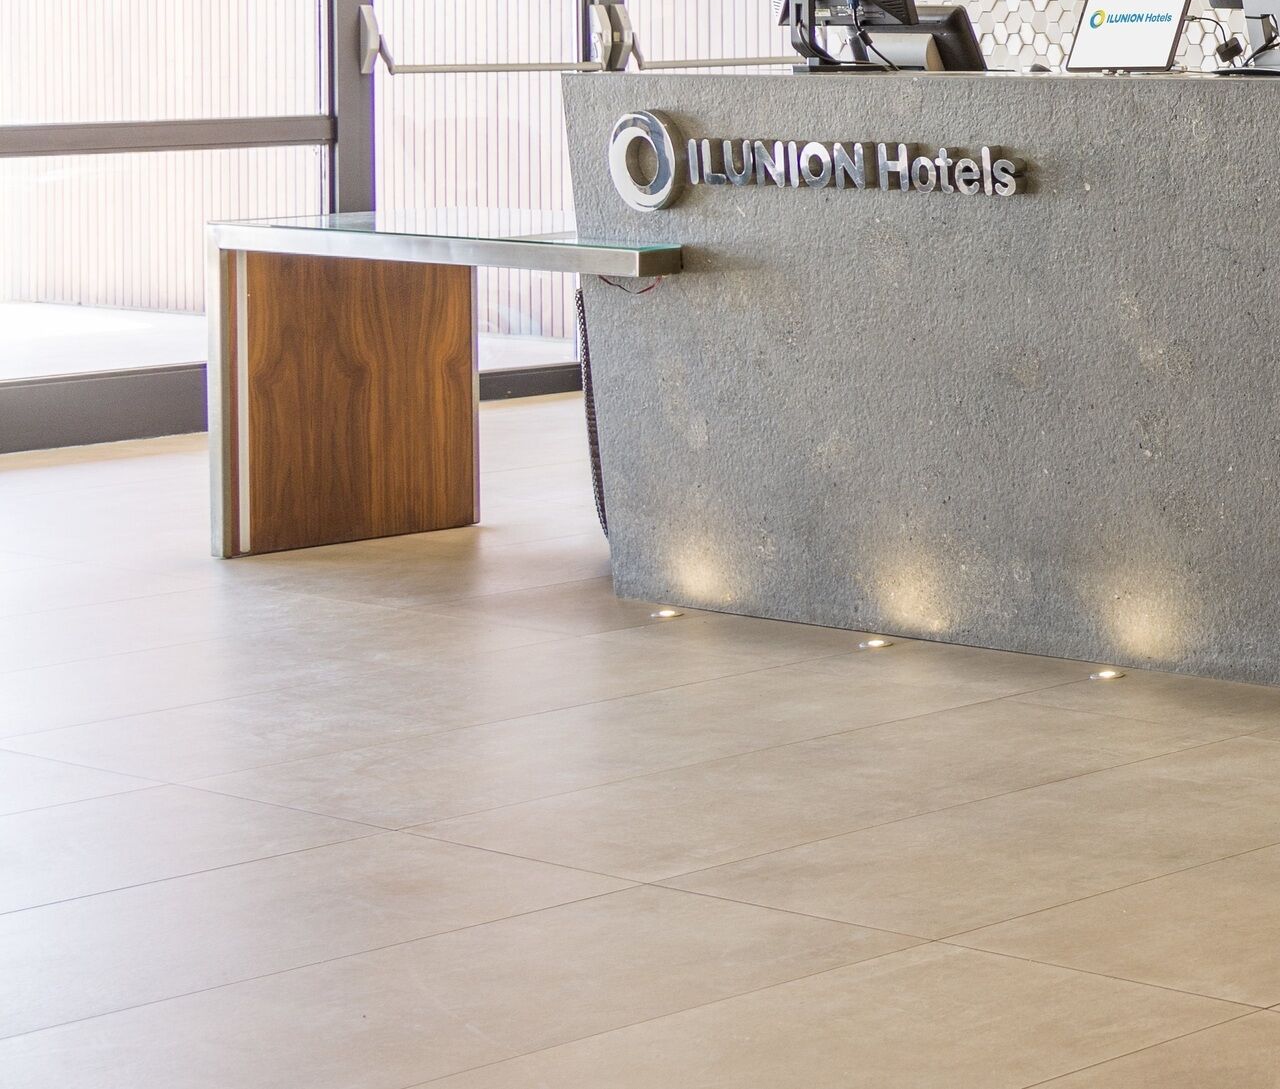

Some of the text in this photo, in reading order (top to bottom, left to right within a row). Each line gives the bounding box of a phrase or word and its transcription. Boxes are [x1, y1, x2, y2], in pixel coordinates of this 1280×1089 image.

[1106, 13, 1172, 23] ILUNION Hotels
[687, 138, 1017, 197] ILUNION Hotels
